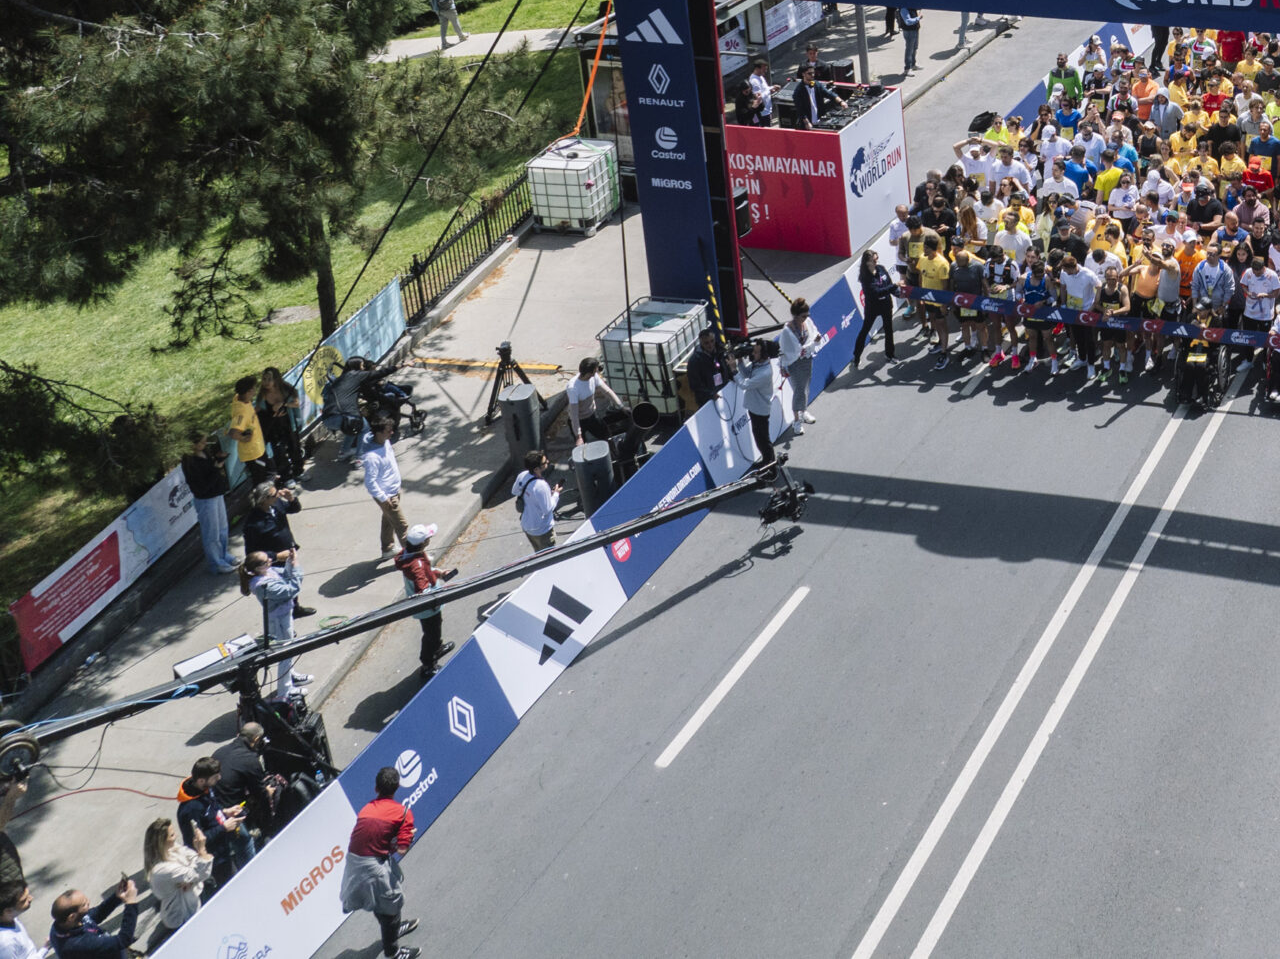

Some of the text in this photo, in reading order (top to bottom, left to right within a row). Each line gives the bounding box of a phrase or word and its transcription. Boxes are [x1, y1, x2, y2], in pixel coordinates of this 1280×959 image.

[638, 96, 686, 108] RENAULT
[651, 149, 687, 161] Castrol
[728, 153, 837, 179] KOŞAMAYANLAR
[859, 145, 902, 193] WORLD RUN
[651, 177, 693, 191] MiGROS
[280, 844, 344, 915] MiGROS
